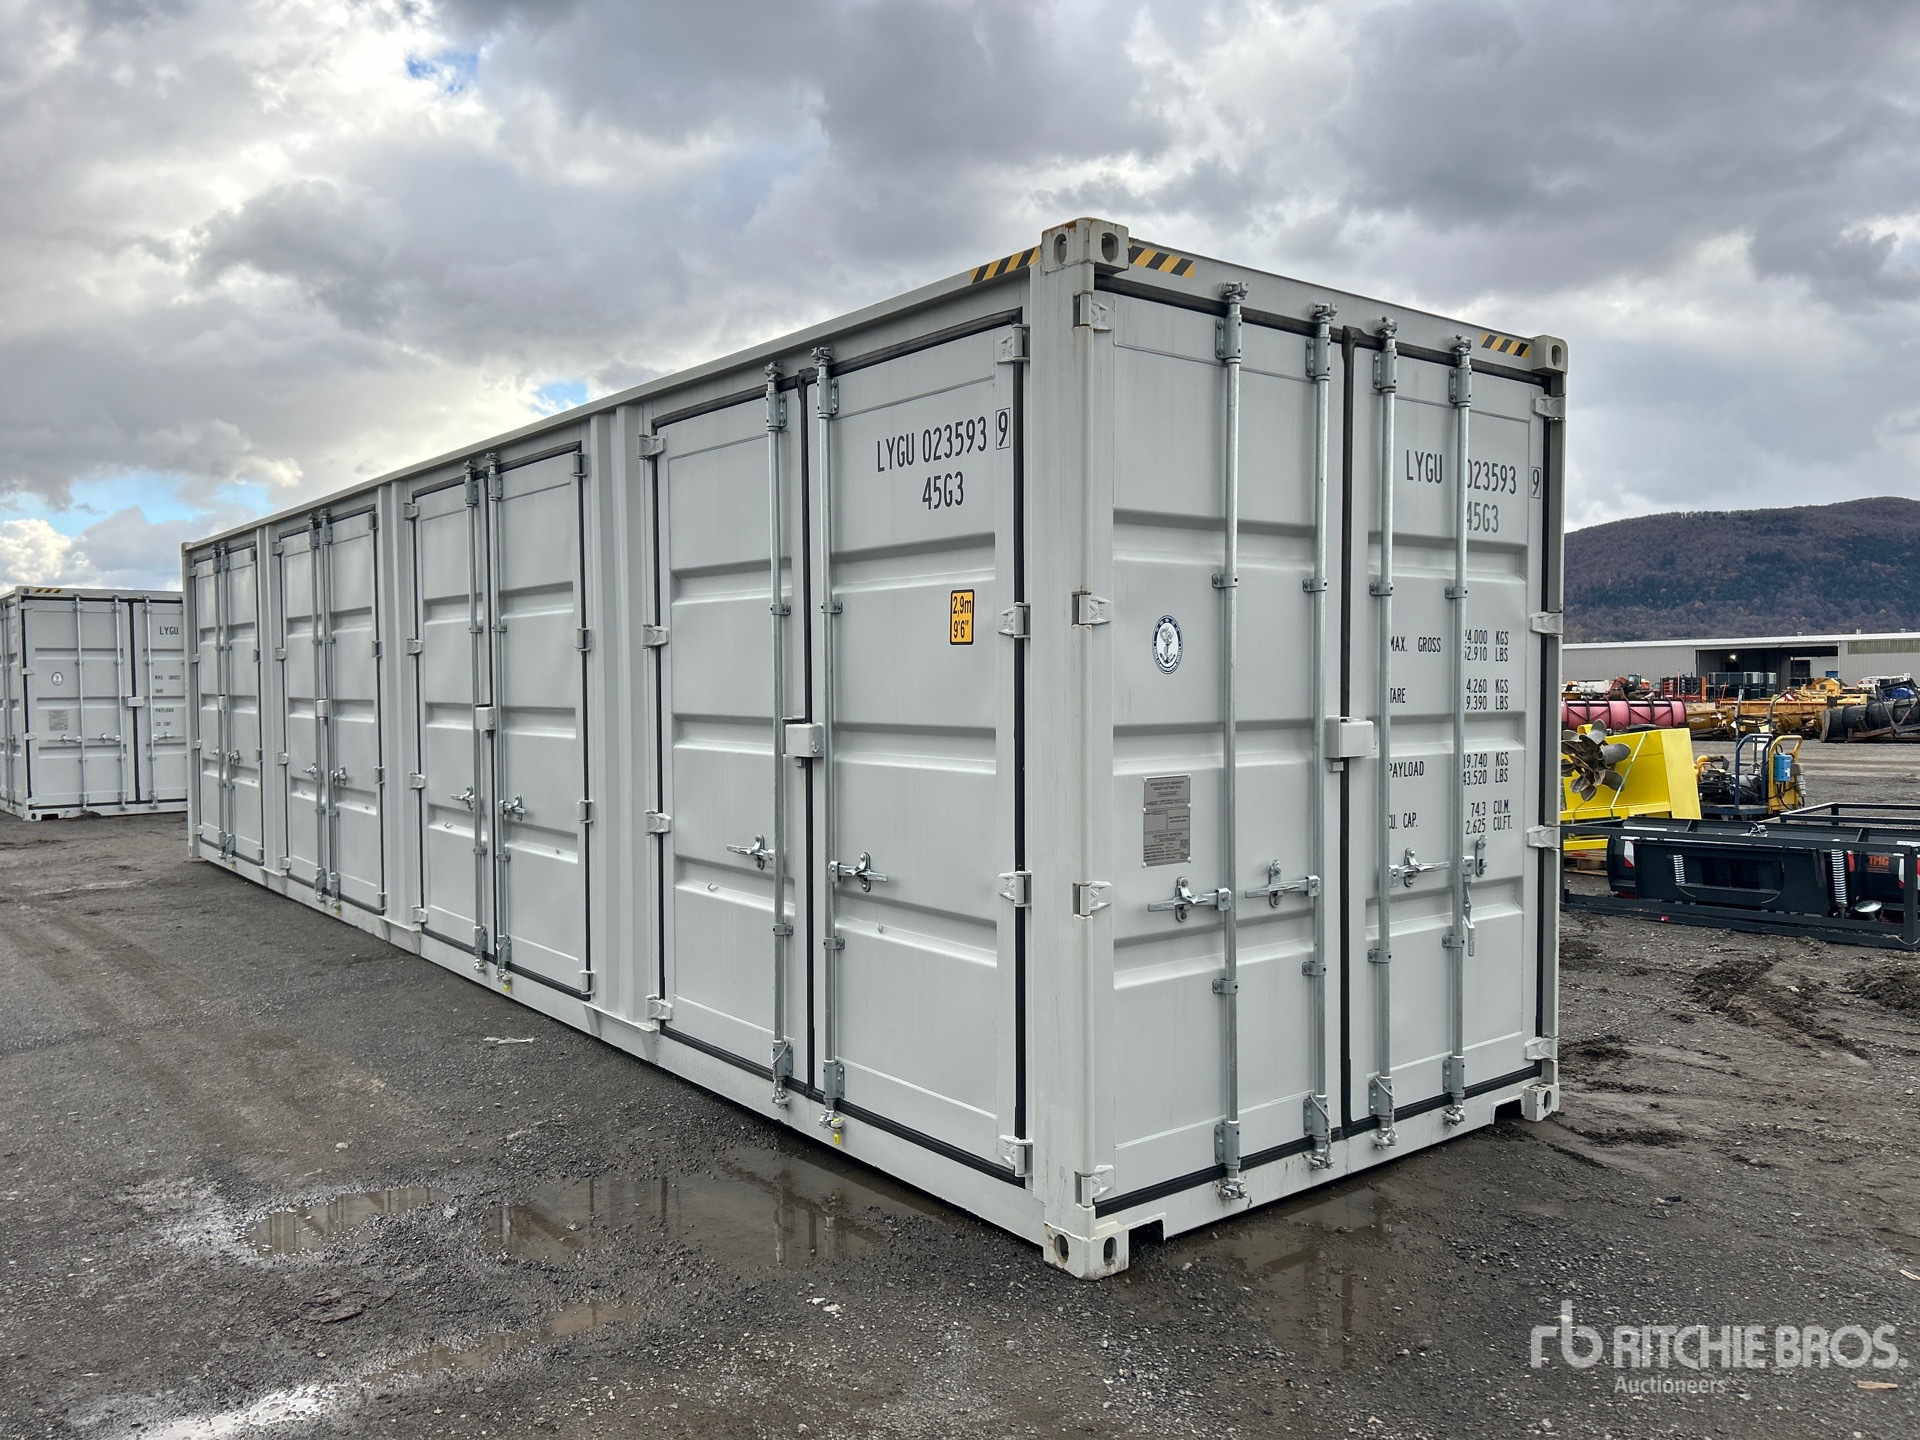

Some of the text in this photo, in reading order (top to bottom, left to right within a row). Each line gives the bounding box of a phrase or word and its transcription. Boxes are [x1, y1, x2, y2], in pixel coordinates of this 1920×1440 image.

[877, 411, 1008, 472] LYGU 023593 9
[1406, 450, 1443, 484] LYGU
[1532, 469, 1540, 496] 9
[922, 471, 964, 510] 45G3
[159, 626, 179, 635] LYGU
[1417, 636, 1442, 653] GROSS
[1495, 630, 1509, 645] KGS
[1495, 647, 1509, 662] LBS
[1495, 679, 1509, 694] KGS
[1495, 695, 1509, 710] LBS
[1495, 752, 1509, 767] KGS
[1495, 768, 1509, 783] LBS
[1403, 812, 1418, 828] CAP.
[1470, 801, 1486, 817] 74.3
